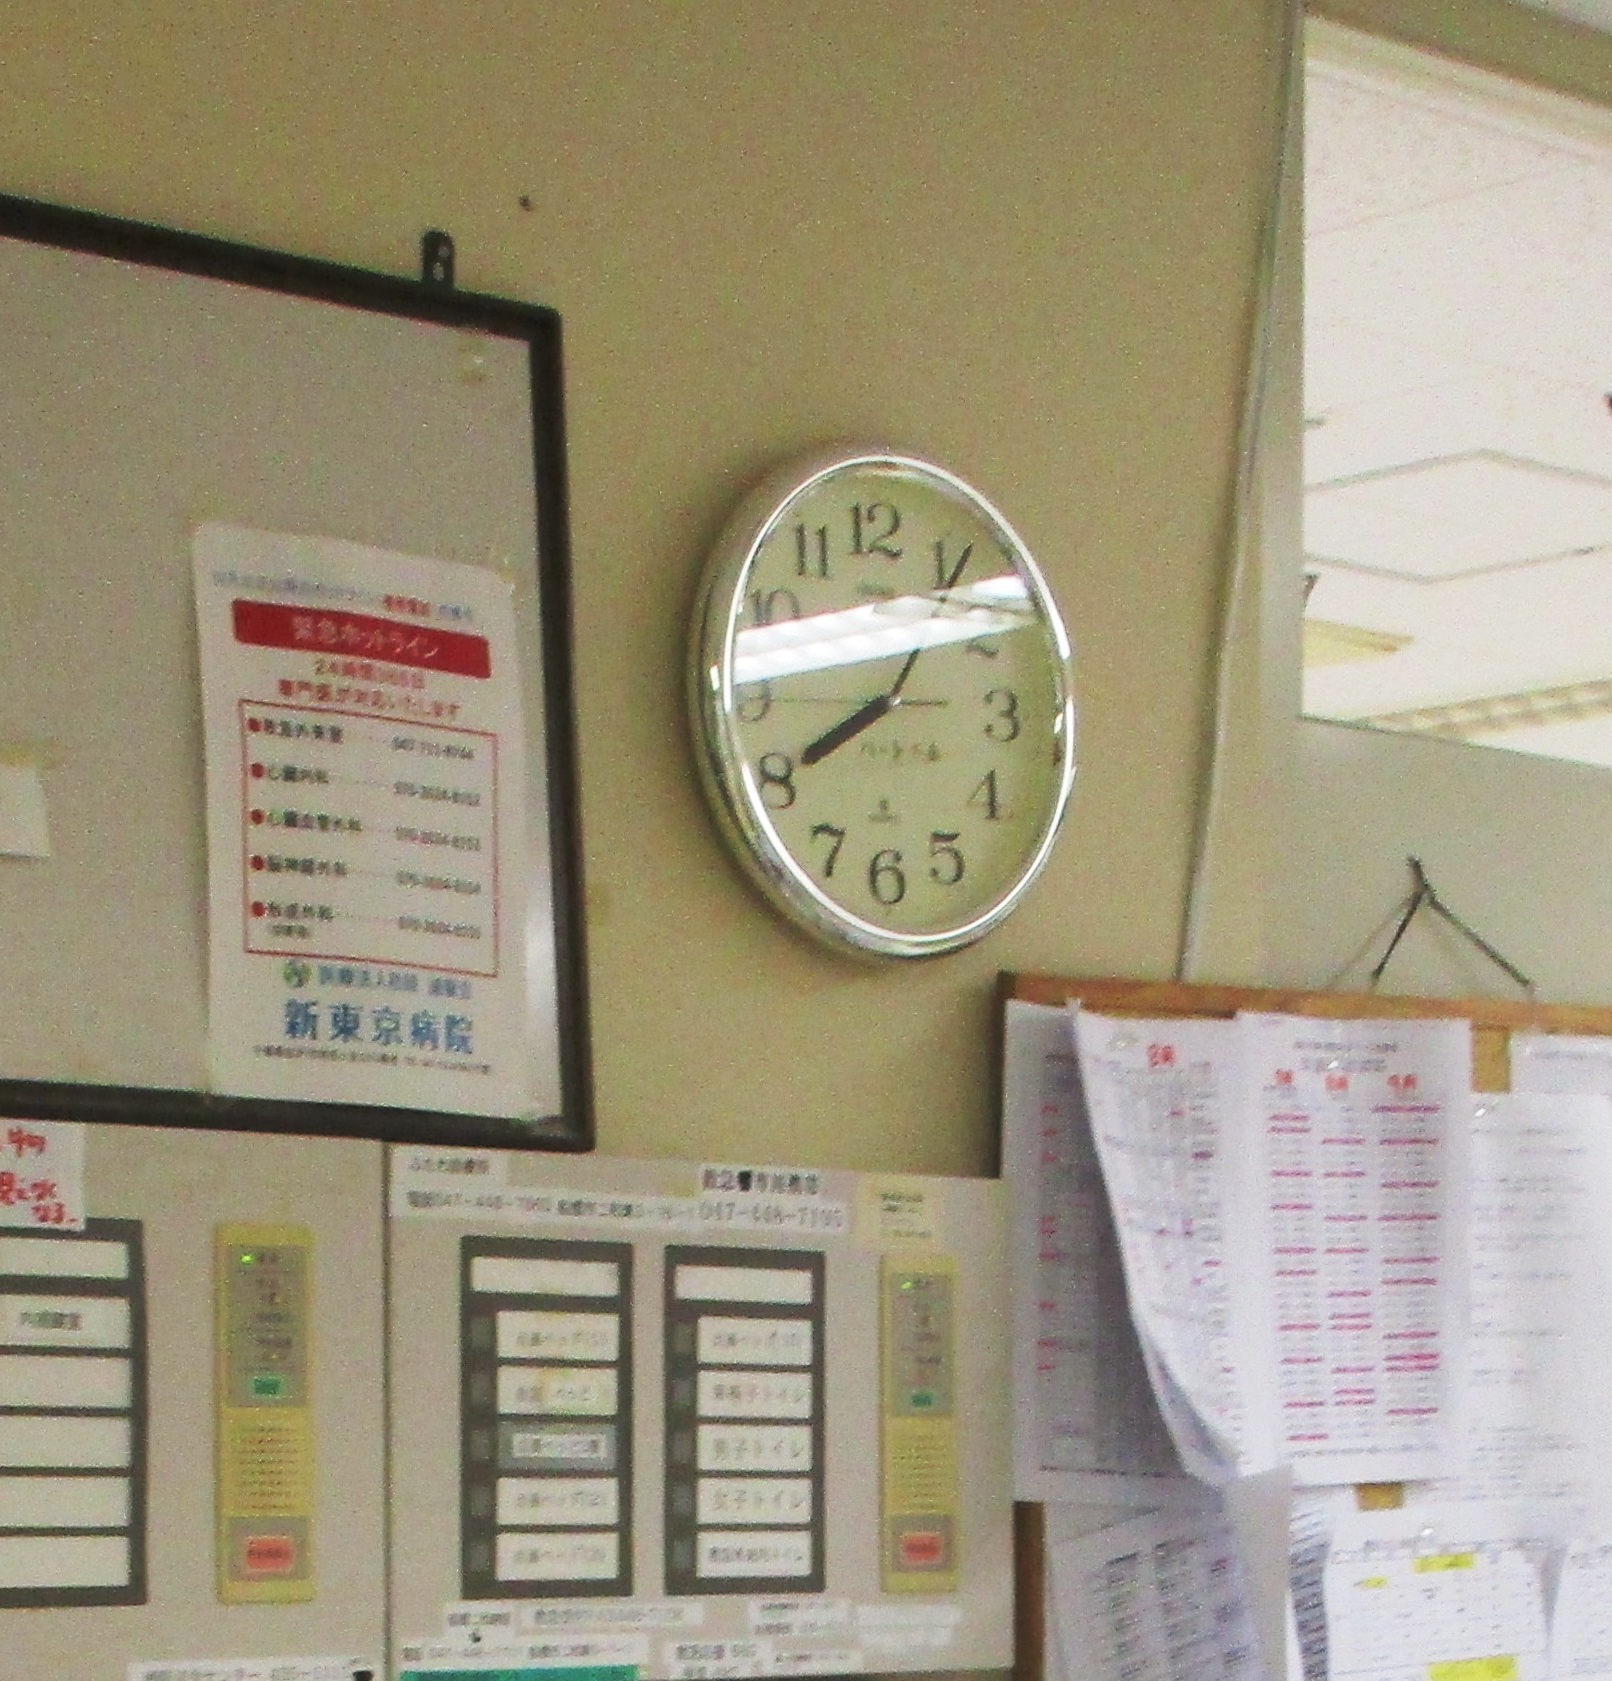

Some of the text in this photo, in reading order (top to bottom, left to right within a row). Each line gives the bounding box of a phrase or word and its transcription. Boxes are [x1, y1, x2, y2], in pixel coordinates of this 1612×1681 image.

[794, 521, 833, 579] 11
[849, 501, 903, 559] 12
[983, 687, 1022, 744] 3
[757, 751, 797, 810] 8
[966, 768, 1002, 821] 4
[810, 822, 846, 879] 7
[868, 848, 907, 906] 6
[928, 830, 967, 885] 5
[283, 997, 475, 1056] 新東京病院
[712, 1438, 803, 1461] 男子トイレ
[712, 1489, 803, 1511] 女子トイレ
